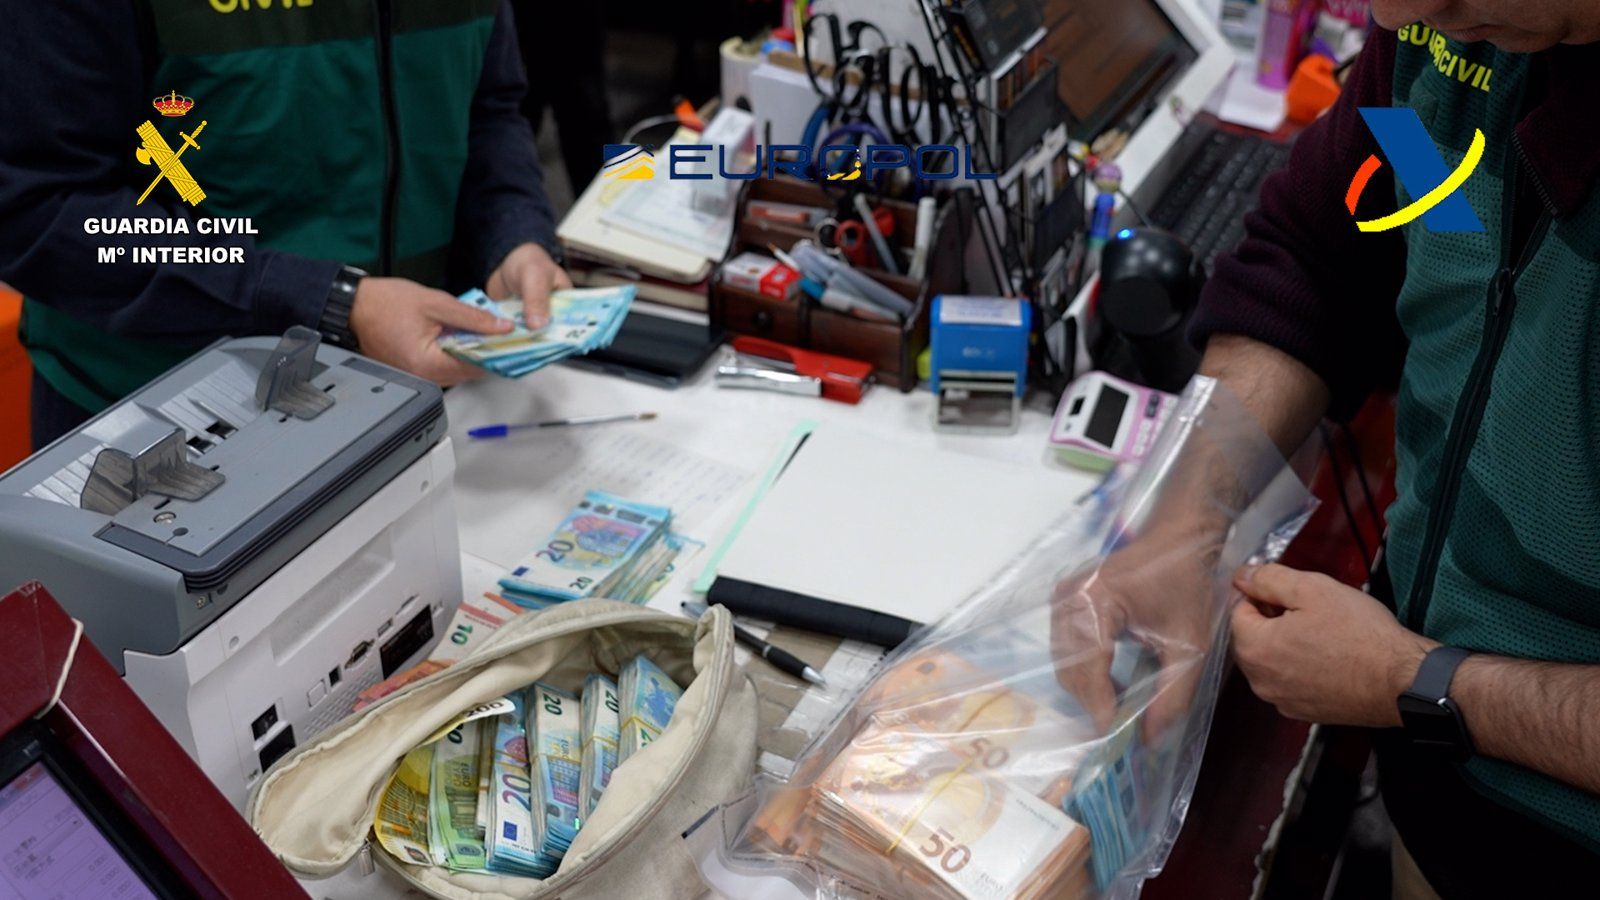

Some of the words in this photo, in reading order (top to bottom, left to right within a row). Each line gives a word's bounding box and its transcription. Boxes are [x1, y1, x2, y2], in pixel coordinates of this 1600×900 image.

[1438, 50, 1493, 92] CIVIL
[534, 540, 575, 563] 20
[569, 576, 593, 590] 20
[450, 623, 473, 646] 10
[543, 693, 563, 716] 20
[969, 737, 1010, 769] 50
[502, 773, 532, 813] 20
[919, 826, 972, 874] 50
